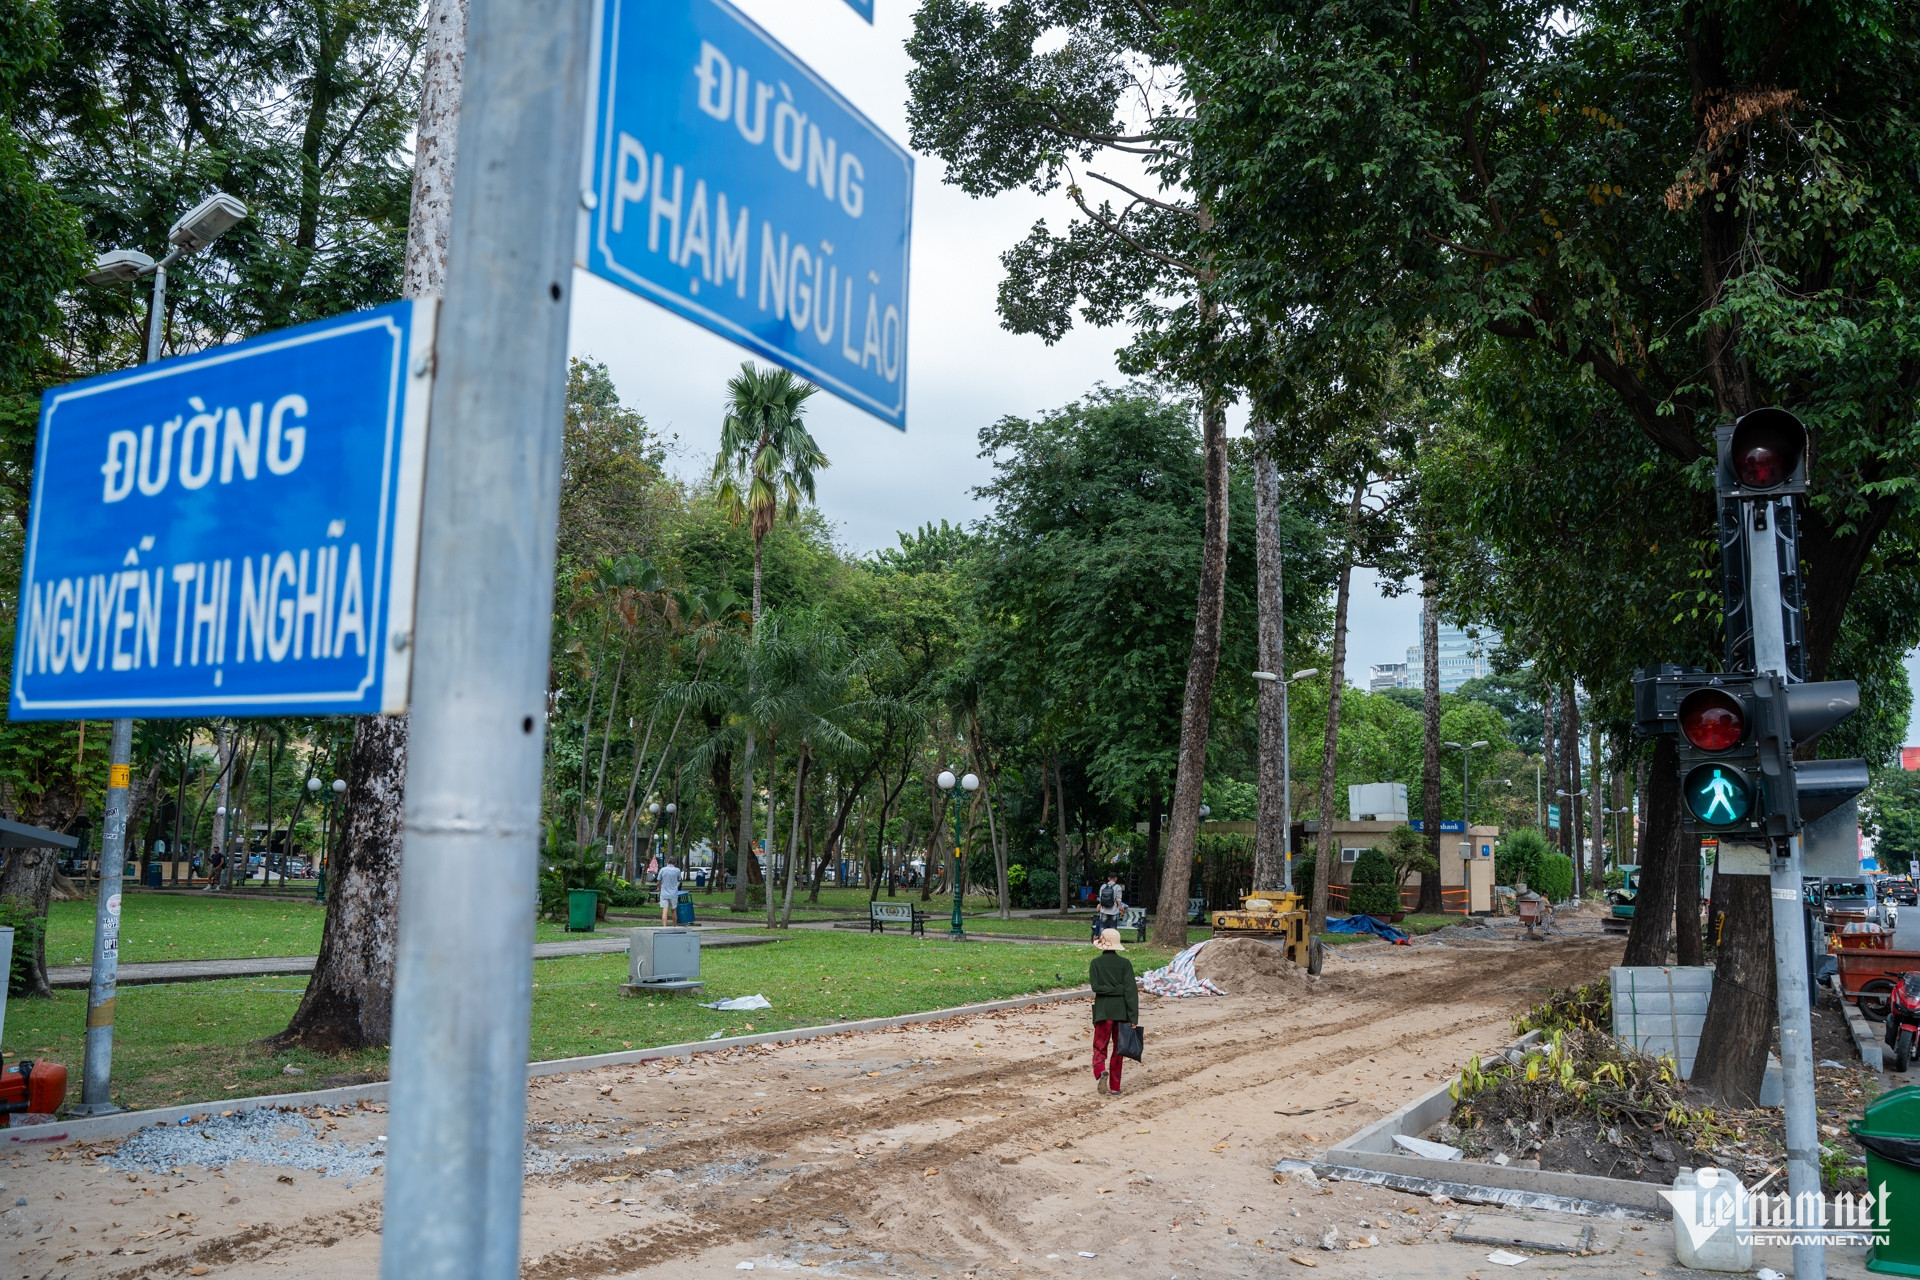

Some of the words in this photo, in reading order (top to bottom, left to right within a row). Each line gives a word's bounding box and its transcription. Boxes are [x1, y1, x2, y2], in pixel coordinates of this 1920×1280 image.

[694, 39, 865, 219] ĐƯỜNG
[611, 130, 749, 299] PHẠM
[758, 220, 838, 345] NGŨ
[842, 269, 901, 384] LÃO
[101, 394, 309, 504] ĐƯỜNG
[25, 535, 164, 676] NGUYỄN
[172, 557, 232, 688] THỊ
[236, 518, 367, 664] NGHĨA
[1419, 821, 1459, 830] Sbank
